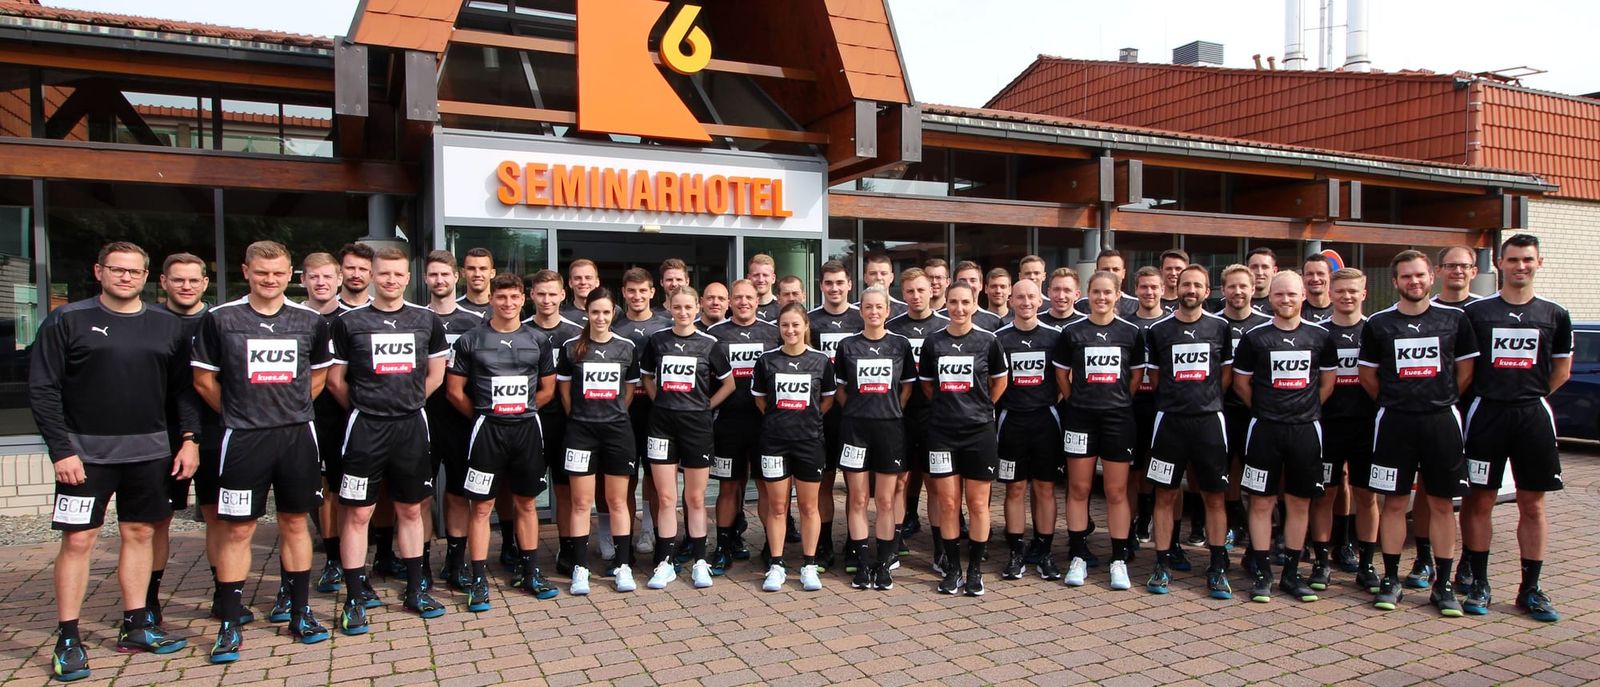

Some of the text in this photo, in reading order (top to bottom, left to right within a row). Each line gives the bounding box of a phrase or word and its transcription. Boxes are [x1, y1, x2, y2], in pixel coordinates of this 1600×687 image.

[496, 160, 793, 218] SEMINARHOTEL
[374, 342, 413, 355] KÜS
[1493, 337, 1537, 350] KÜS
[250, 349, 295, 363] KÜS
[1174, 351, 1208, 364] KÜS
[1397, 346, 1438, 360] KÜS
[1013, 359, 1045, 371] KÜS
[1086, 355, 1120, 366] KÜS
[1273, 359, 1310, 371] KÜS
[1498, 359, 1528, 367] kues.de
[380, 364, 408, 372] kues.de
[662, 363, 695, 376] KÜS
[858, 366, 891, 377] KÜS
[939, 363, 972, 375] KÜS
[1404, 368, 1432, 376] kues.de
[585, 371, 619, 382] KÜS
[493, 384, 527, 397] KÜS
[777, 381, 810, 393] KÜS
[1065, 432, 1086, 446] GCH
[567, 450, 589, 463] GCH
[843, 446, 865, 459] GCH
[930, 452, 950, 464] GCH
[762, 457, 782, 469] GCH
[1151, 457, 1172, 474] GCH
[468, 471, 491, 486] GCH
[1245, 466, 1266, 483] GCH
[1371, 466, 1395, 482] GCH
[342, 476, 366, 491] GCH
[222, 490, 249, 505] GCH
[58, 497, 91, 513] GCH
